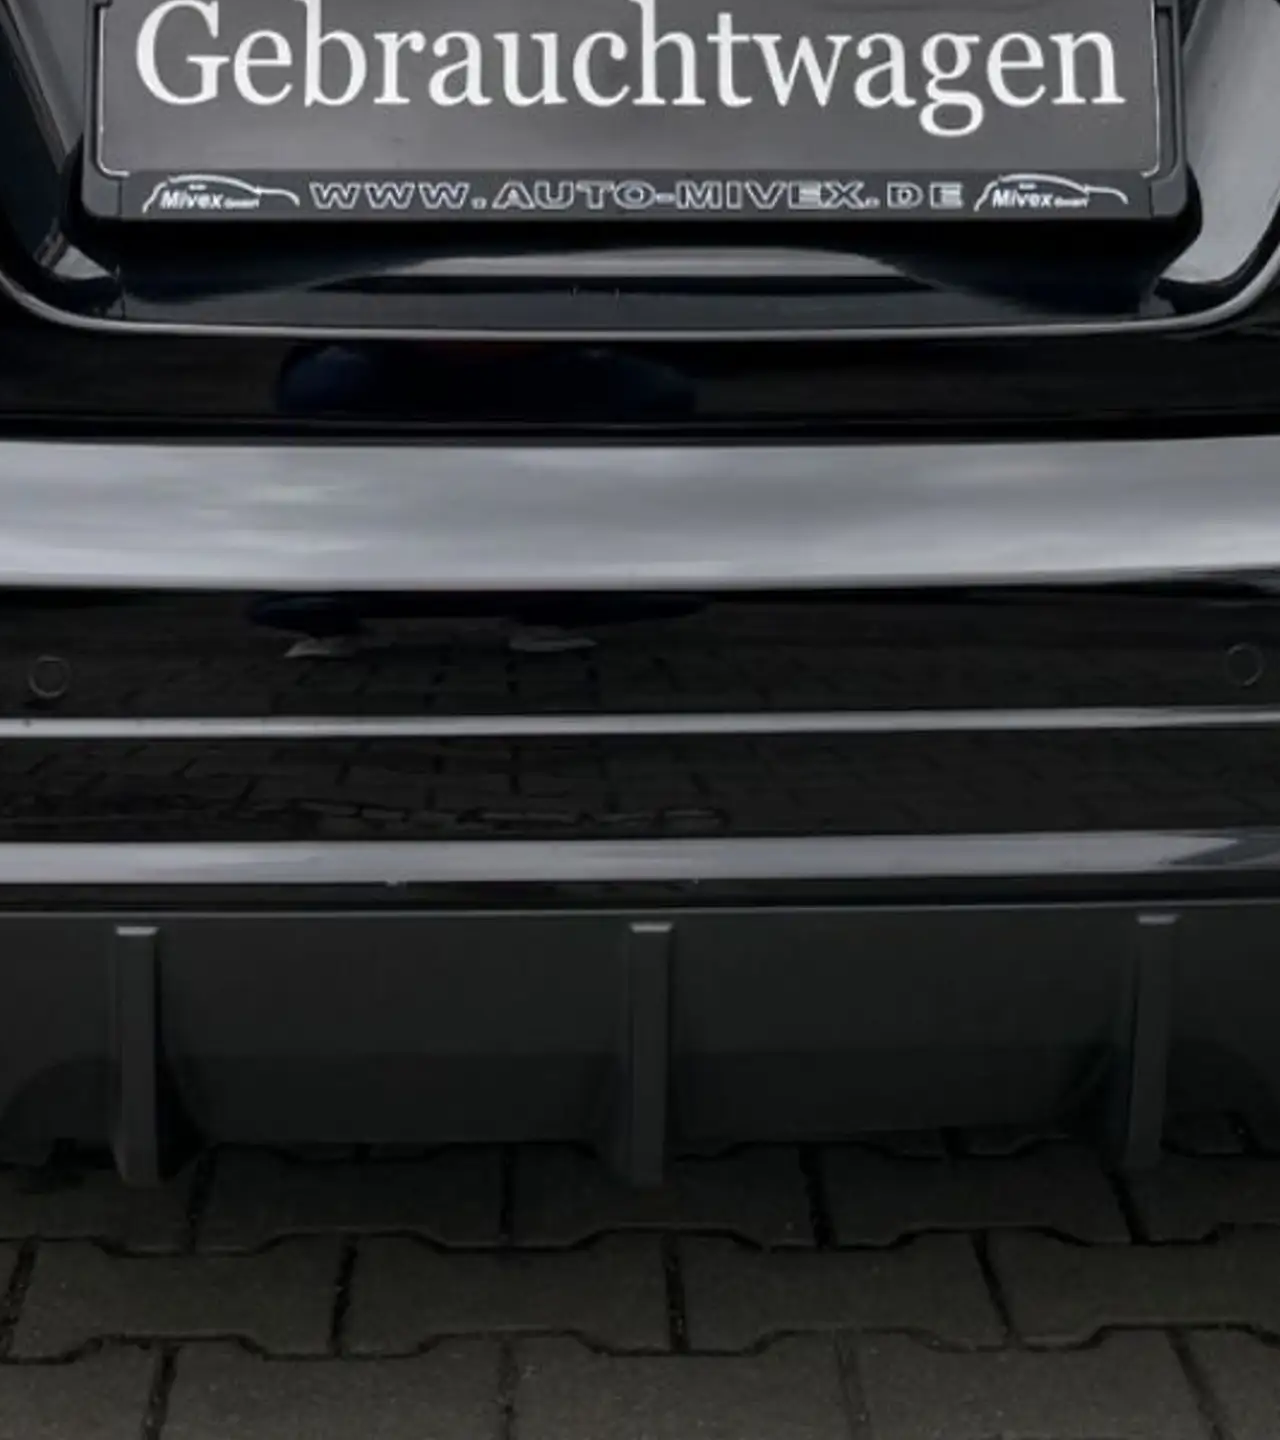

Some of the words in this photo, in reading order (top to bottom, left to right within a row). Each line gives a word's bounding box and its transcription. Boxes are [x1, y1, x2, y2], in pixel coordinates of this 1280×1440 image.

[160, 189, 224, 210] Mivex
[309, 180, 965, 210] WWW.AUTO-MIVEX.DE
[991, 188, 1054, 209] Mivex
